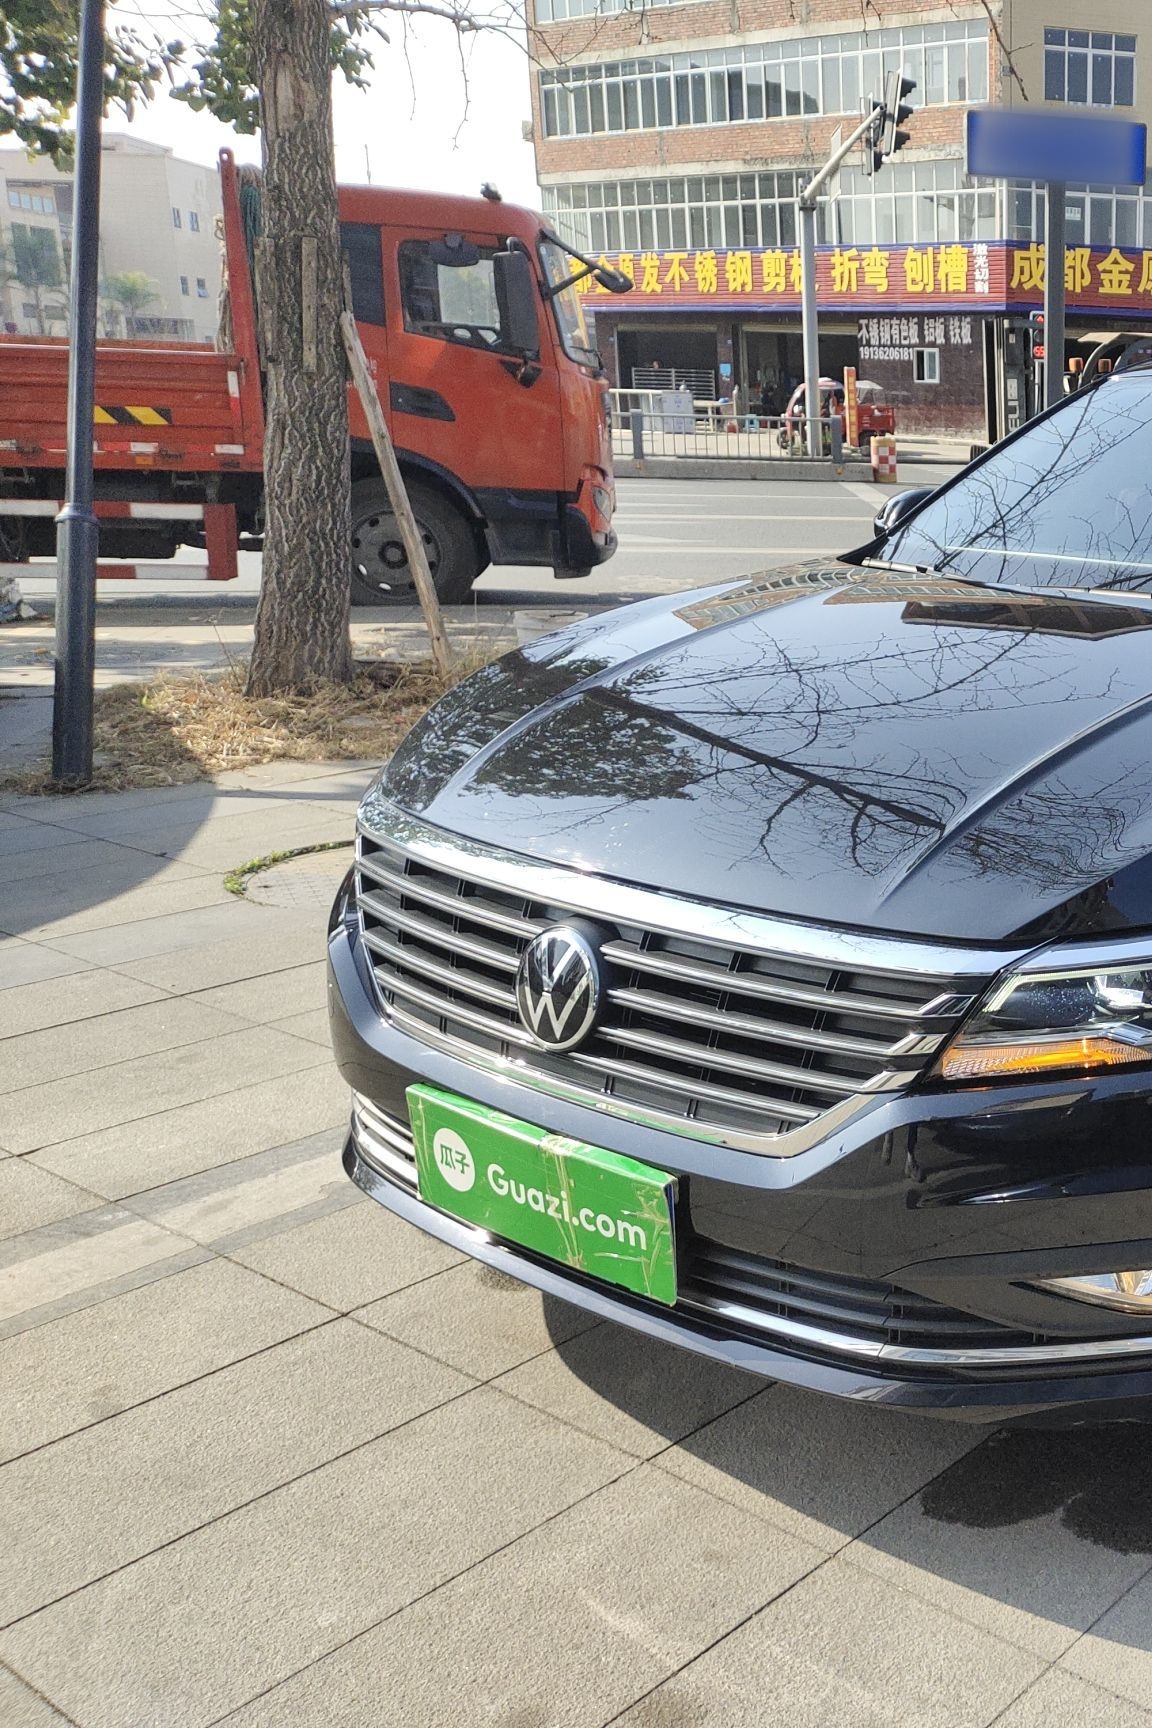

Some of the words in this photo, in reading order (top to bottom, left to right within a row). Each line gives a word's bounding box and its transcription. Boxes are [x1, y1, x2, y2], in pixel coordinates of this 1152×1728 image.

[830, 246, 890, 293] 折弯
[903, 245, 969, 293] 刨槽
[973, 243, 989, 293] 激光切割
[857, 316, 919, 345] 不锈钢有色板
[923, 316, 946, 344] 铝板
[949, 315, 972, 344] 铁板
[859, 346, 914, 360] 19136206181
[440, 1142, 470, 1175] 瓜子
[487, 1163, 647, 1251] Guazi.com
